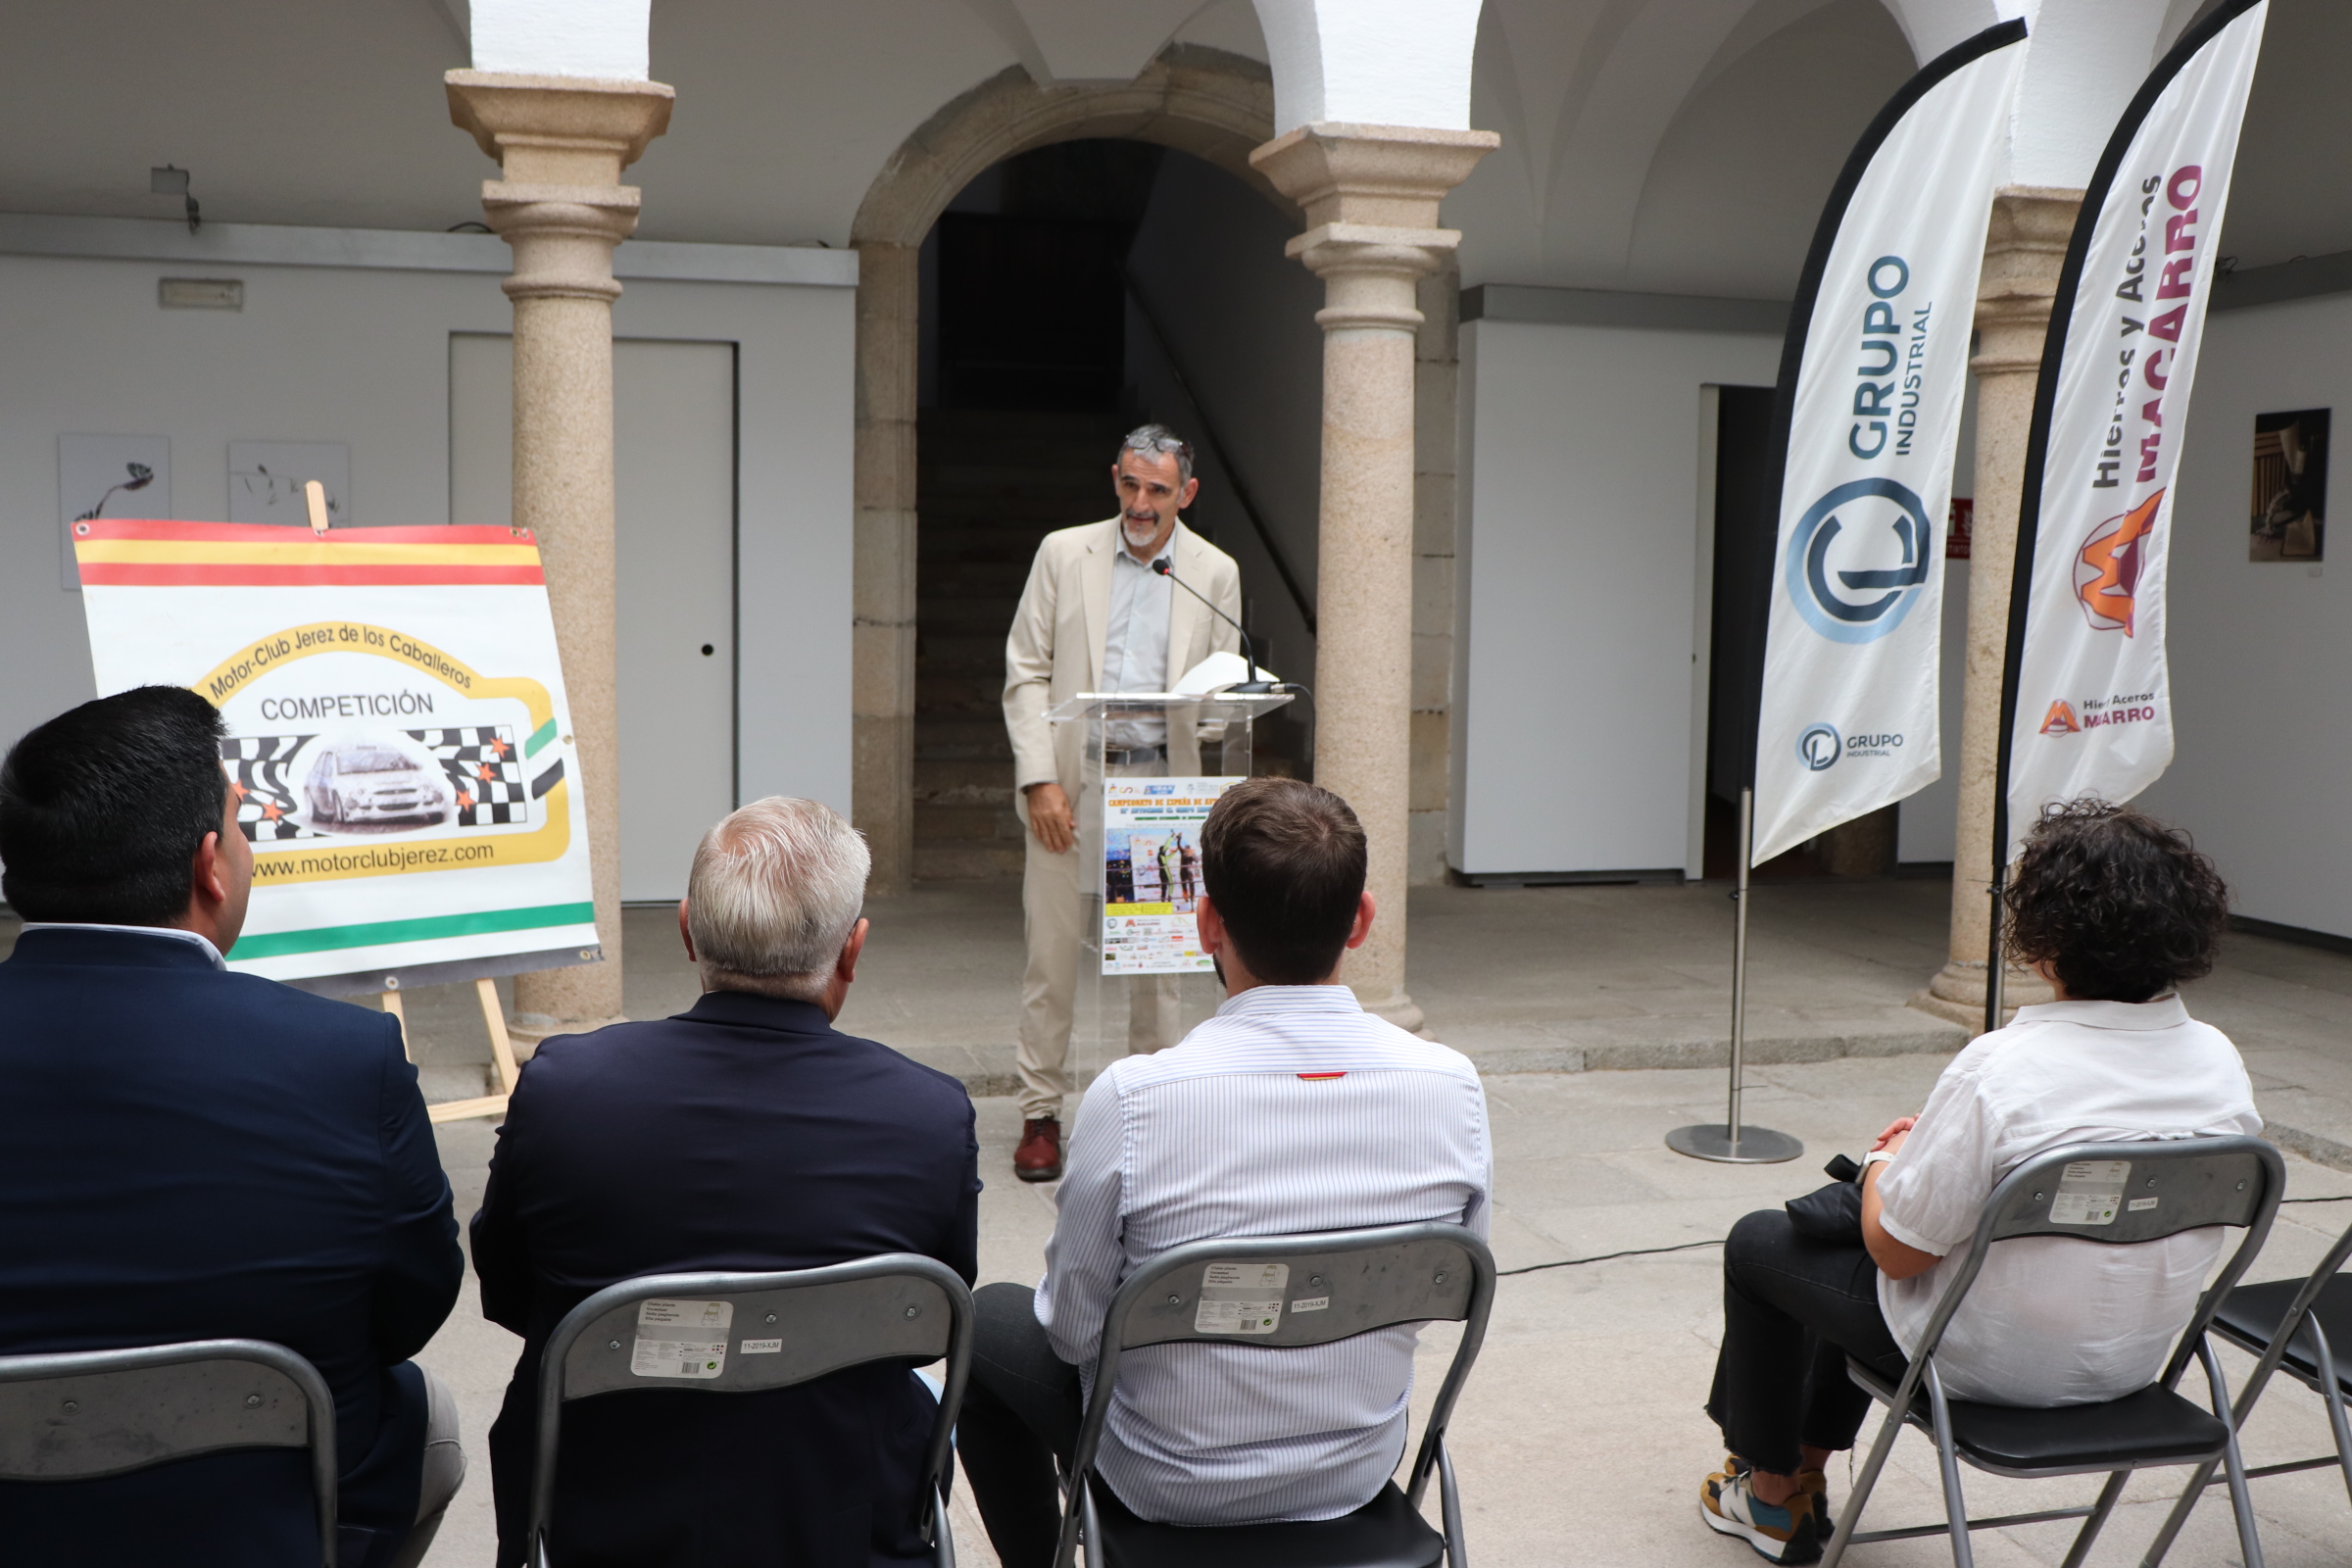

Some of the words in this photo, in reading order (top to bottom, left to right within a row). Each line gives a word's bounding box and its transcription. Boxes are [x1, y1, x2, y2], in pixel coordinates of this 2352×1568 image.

[1848, 255, 1910, 461] GRUPO
[1895, 300, 1933, 456] INDUSTRIAL
[2091, 348, 2136, 489] Hierros
[209, 638, 291, 700] Motor-Club
[295, 627, 335, 650] Jerez
[339, 624, 359, 643] de
[363, 626, 385, 647] los
[389, 635, 471, 690] Caballeros
[2112, 691, 2156, 706] Aceros
[261, 689, 434, 721] COMPETICIÓN
[1846, 733, 1904, 749] GRUPO
